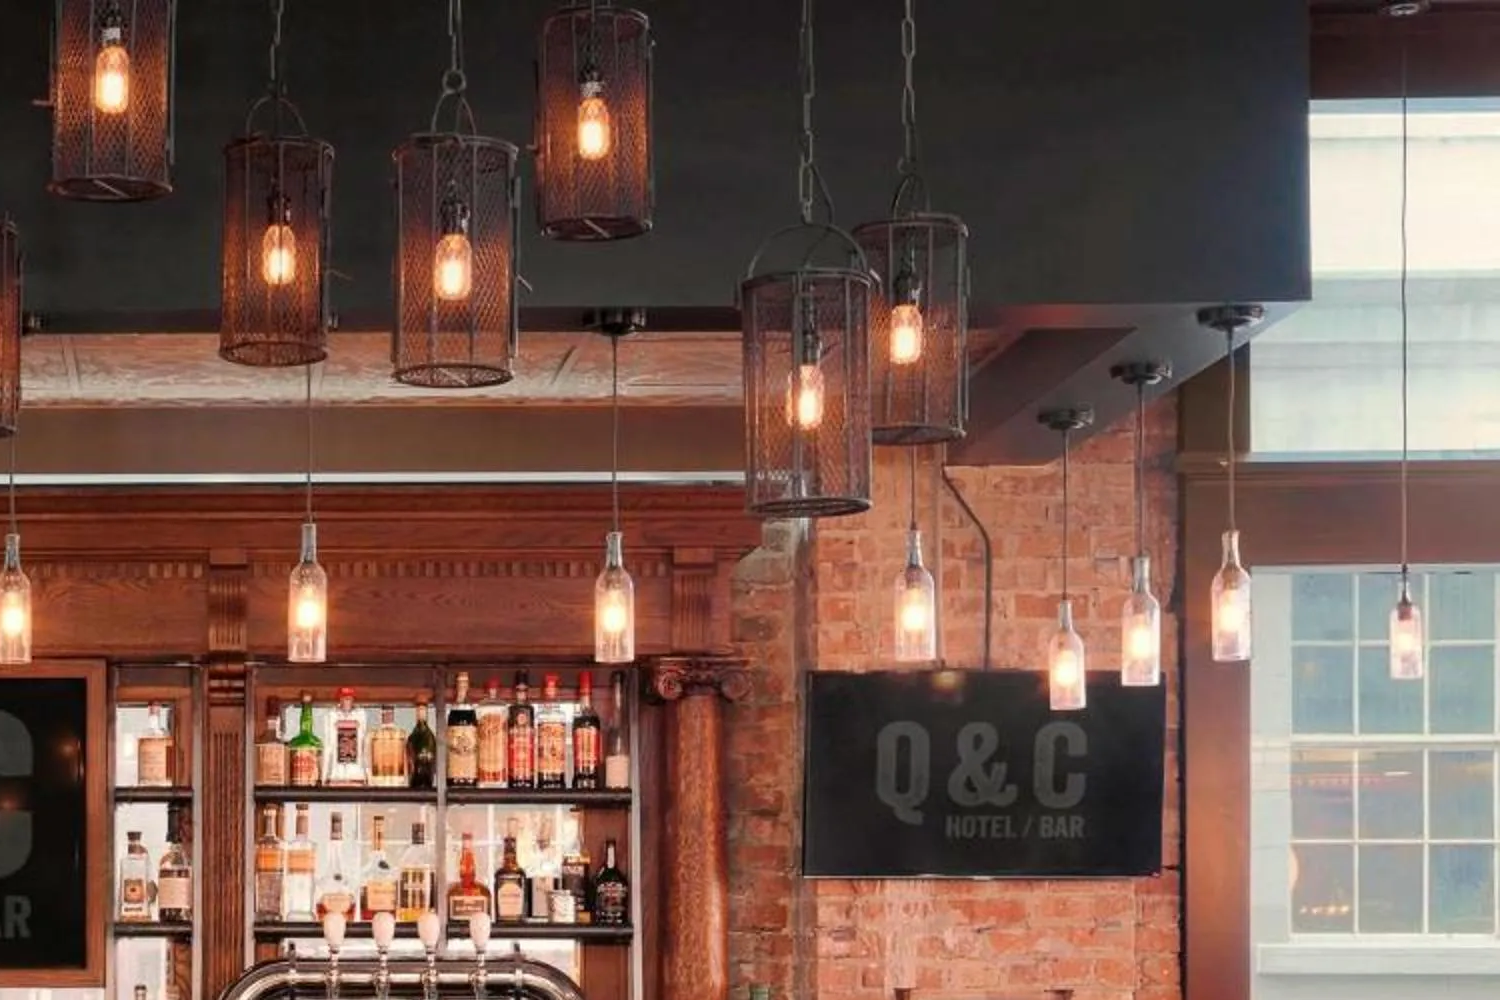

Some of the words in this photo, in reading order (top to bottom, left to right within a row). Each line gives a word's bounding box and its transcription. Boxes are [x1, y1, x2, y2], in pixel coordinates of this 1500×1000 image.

[876, 720, 931, 825] Q
[948, 721, 1018, 807] &
[1034, 721, 1088, 809] C
[946, 815, 1016, 839] HOTEL
[1023, 816, 1033, 838] /
[1040, 815, 1085, 839] BAR
